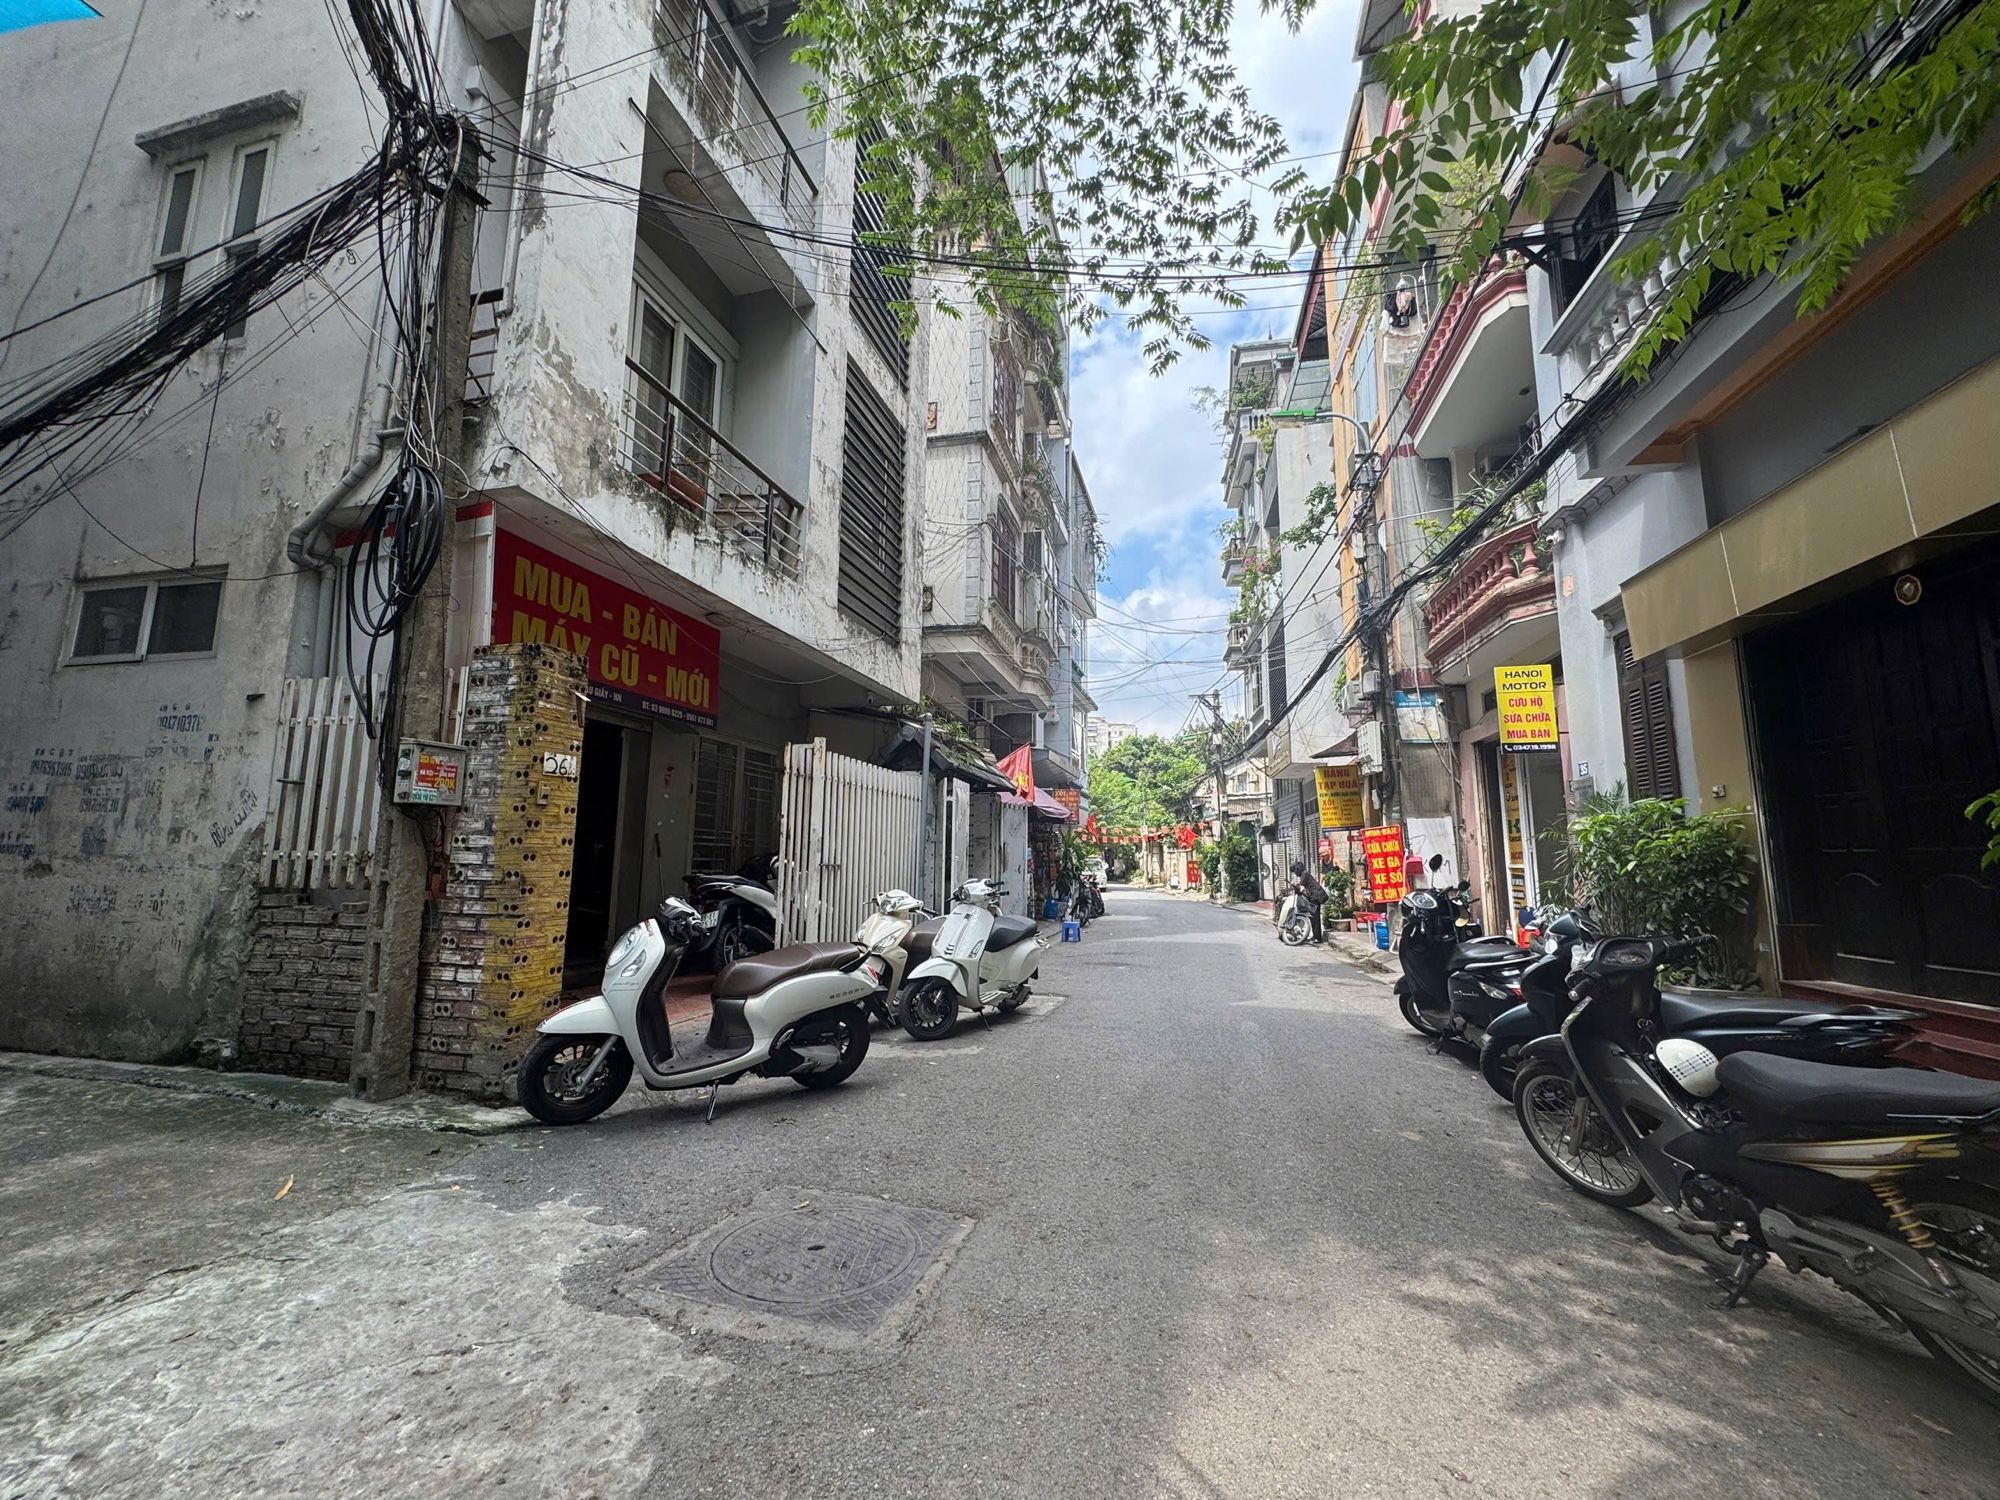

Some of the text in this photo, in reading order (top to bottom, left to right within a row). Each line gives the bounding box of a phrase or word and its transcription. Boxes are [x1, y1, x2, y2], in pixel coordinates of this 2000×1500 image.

[513, 555, 592, 623] MUA
[623, 602, 679, 655] BÁN
[512, 610, 591, 656] MÁY
[600, 643, 640, 687] CŨ
[665, 665, 711, 709] MỚI
[1504, 670, 1543, 679] HANOI
[1502, 682, 1547, 690] MOTOR
[1530, 695, 1543, 709] HỘ
[1503, 710, 1551, 723] SỬA CHỮA
[1506, 727, 1551, 740] MUA BÁN
[1318, 781, 1336, 791] TẠP
[1367, 839, 1381, 854] SỬA
[1372, 856, 1401, 869] XE GA
[1374, 873, 1388, 885] XE
[1374, 888, 1384, 900] XE
